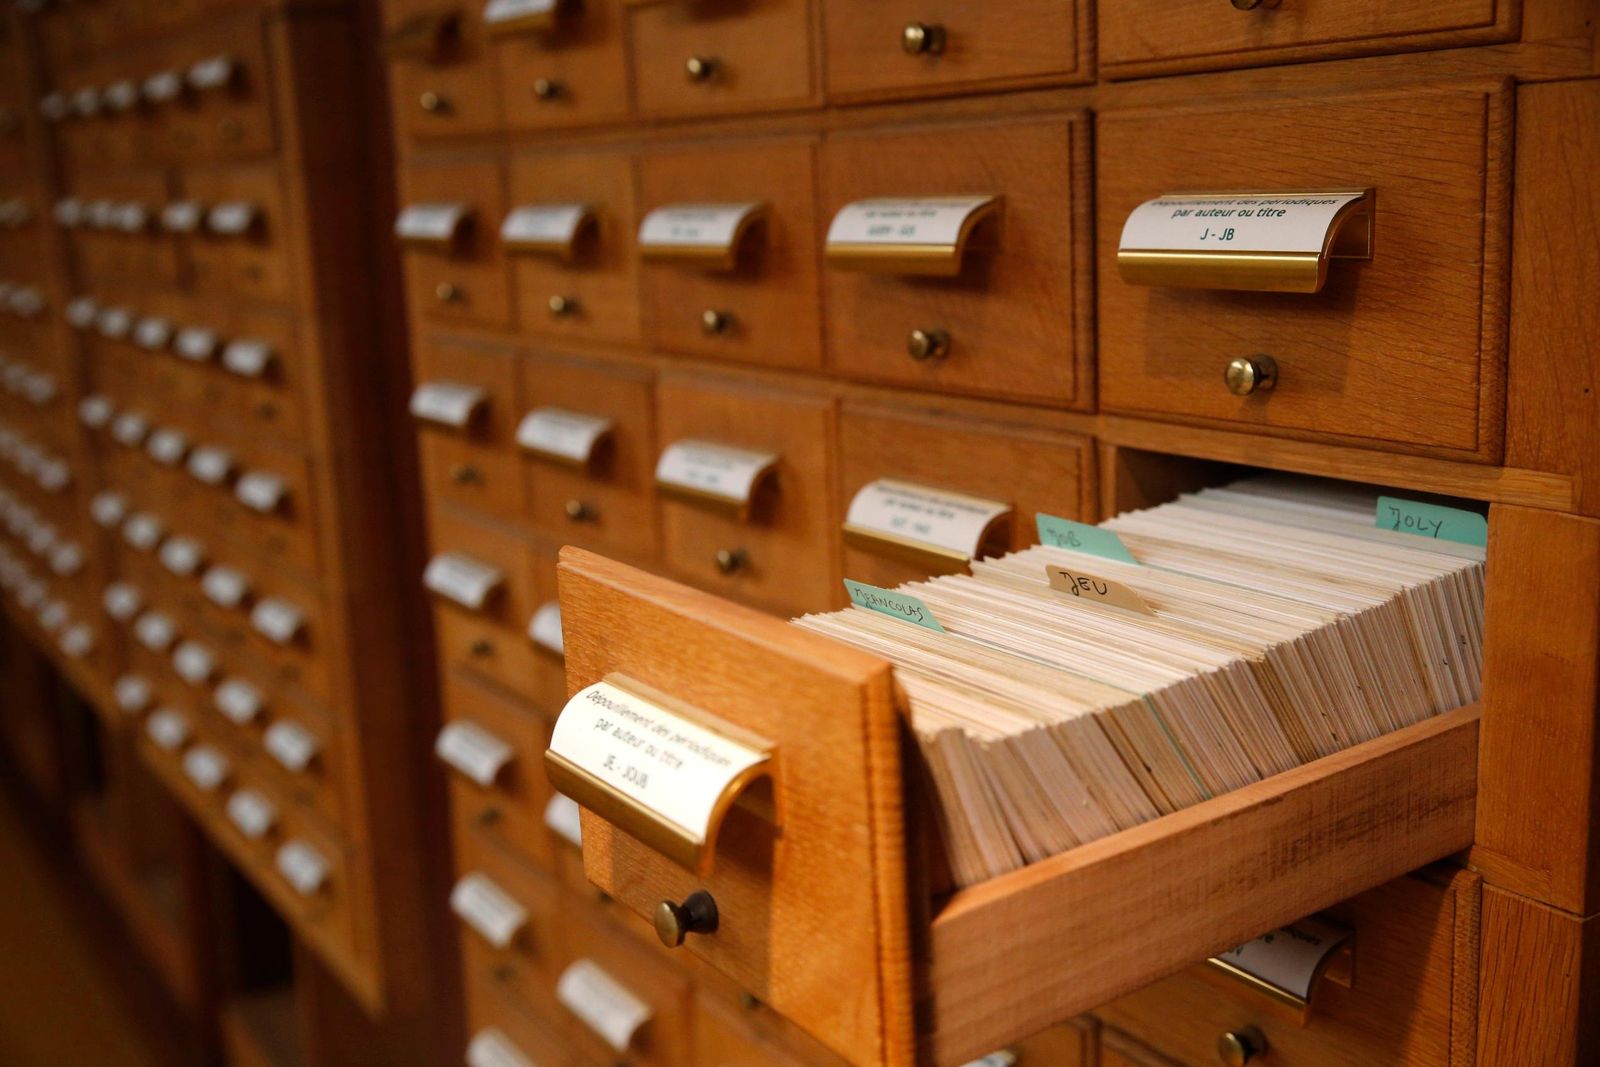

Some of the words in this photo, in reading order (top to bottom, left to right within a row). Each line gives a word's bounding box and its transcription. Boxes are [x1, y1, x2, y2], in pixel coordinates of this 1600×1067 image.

[1171, 207, 1196, 219] par
[1195, 207, 1236, 217] auteur
[1238, 207, 1254, 217] ou
[1256, 207, 1287, 217] titre
[1200, 228, 1210, 241] J
[1218, 228, 1235, 241] JB
[1389, 506, 1443, 539] JOLY
[1058, 571, 1108, 597] JEU
[593, 718, 614, 732] par
[612, 727, 646, 748] auteur
[645, 744, 659, 757] ou
